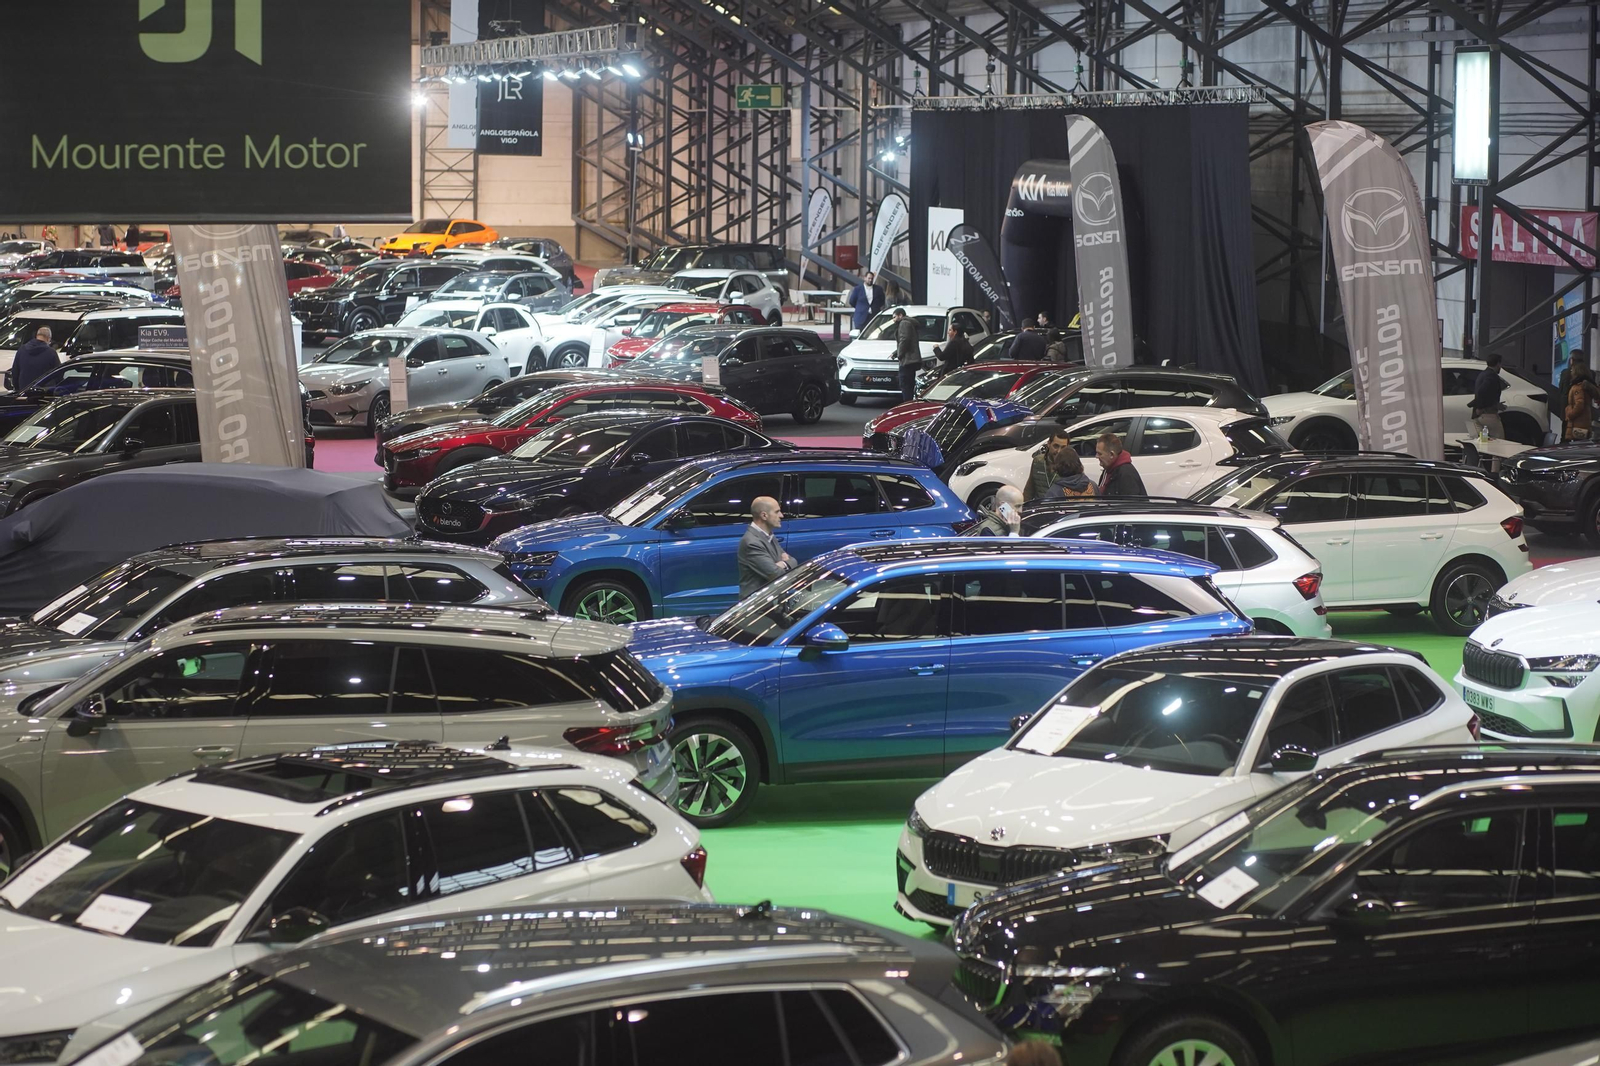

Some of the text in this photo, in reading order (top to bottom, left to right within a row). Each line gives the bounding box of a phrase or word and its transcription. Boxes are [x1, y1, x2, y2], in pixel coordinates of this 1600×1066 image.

[497, 79, 523, 102] JLR
[480, 129, 538, 137] ANGLOESPAÑOLA
[31, 134, 367, 170] Mourente Motor
[873, 201, 902, 256] DEFENDER
[1469, 211, 1587, 258] SALIDA
[440, 518, 461, 527] blendio
